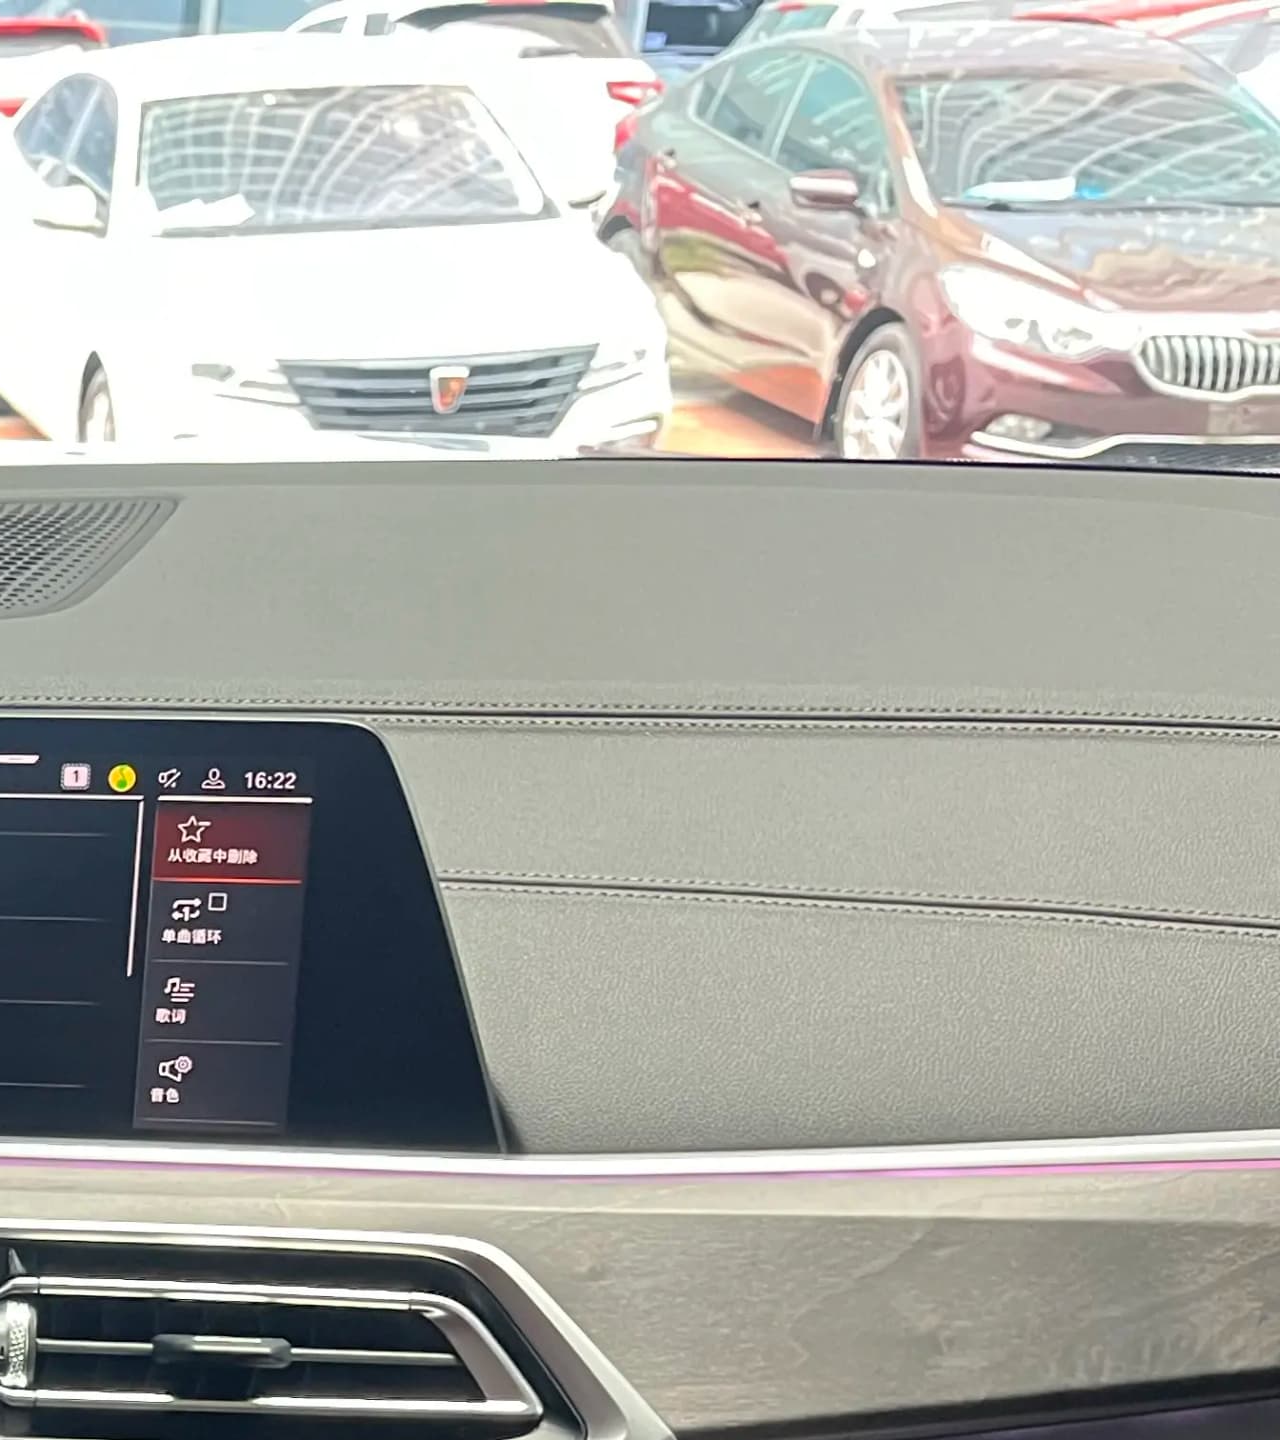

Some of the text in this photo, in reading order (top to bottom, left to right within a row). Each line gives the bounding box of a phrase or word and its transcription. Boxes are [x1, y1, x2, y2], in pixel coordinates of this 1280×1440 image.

[244, 772, 297, 789] 16:22
[168, 848, 258, 864] 从收藏中删除
[161, 929, 222, 945] 单曲循环
[155, 1008, 187, 1024] 歌词
[150, 1088, 180, 1103] 音色
